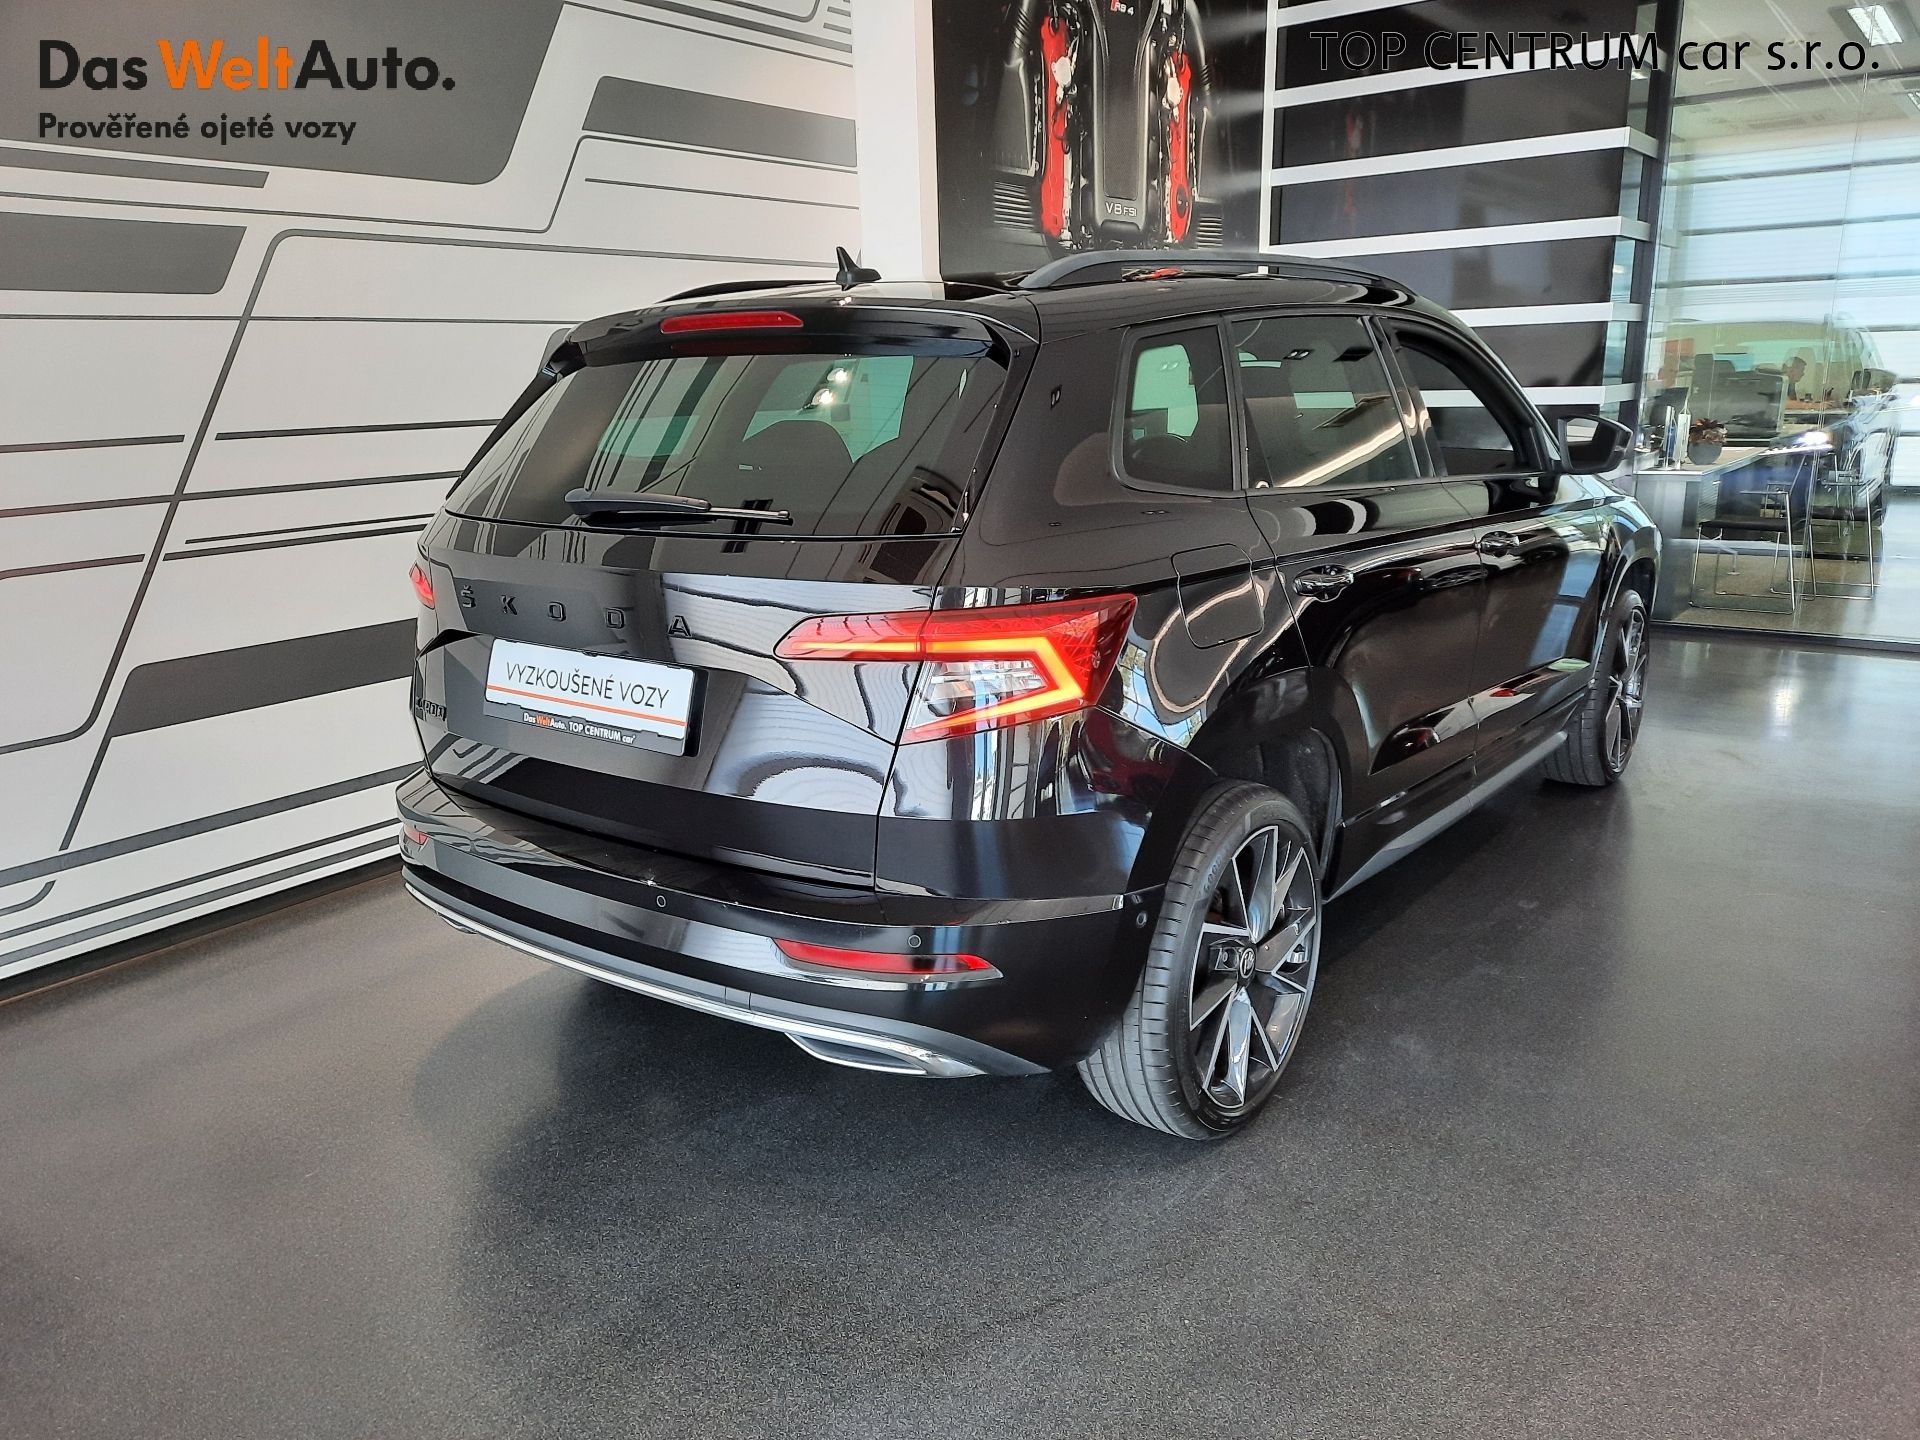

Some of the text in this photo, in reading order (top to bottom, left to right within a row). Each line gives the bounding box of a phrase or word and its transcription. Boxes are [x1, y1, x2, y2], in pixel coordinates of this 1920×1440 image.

[1105, 202, 1137, 217] V8 FSI
[461, 585, 692, 638] ŠKODA
[506, 661, 670, 709] VYZKOUŠENÉ VOZY
[523, 712, 536, 724] Das
[536, 714, 567, 730] WeltAuto.
[568, 721, 584, 733] TOP
[584, 724, 621, 741] CENTRUM
